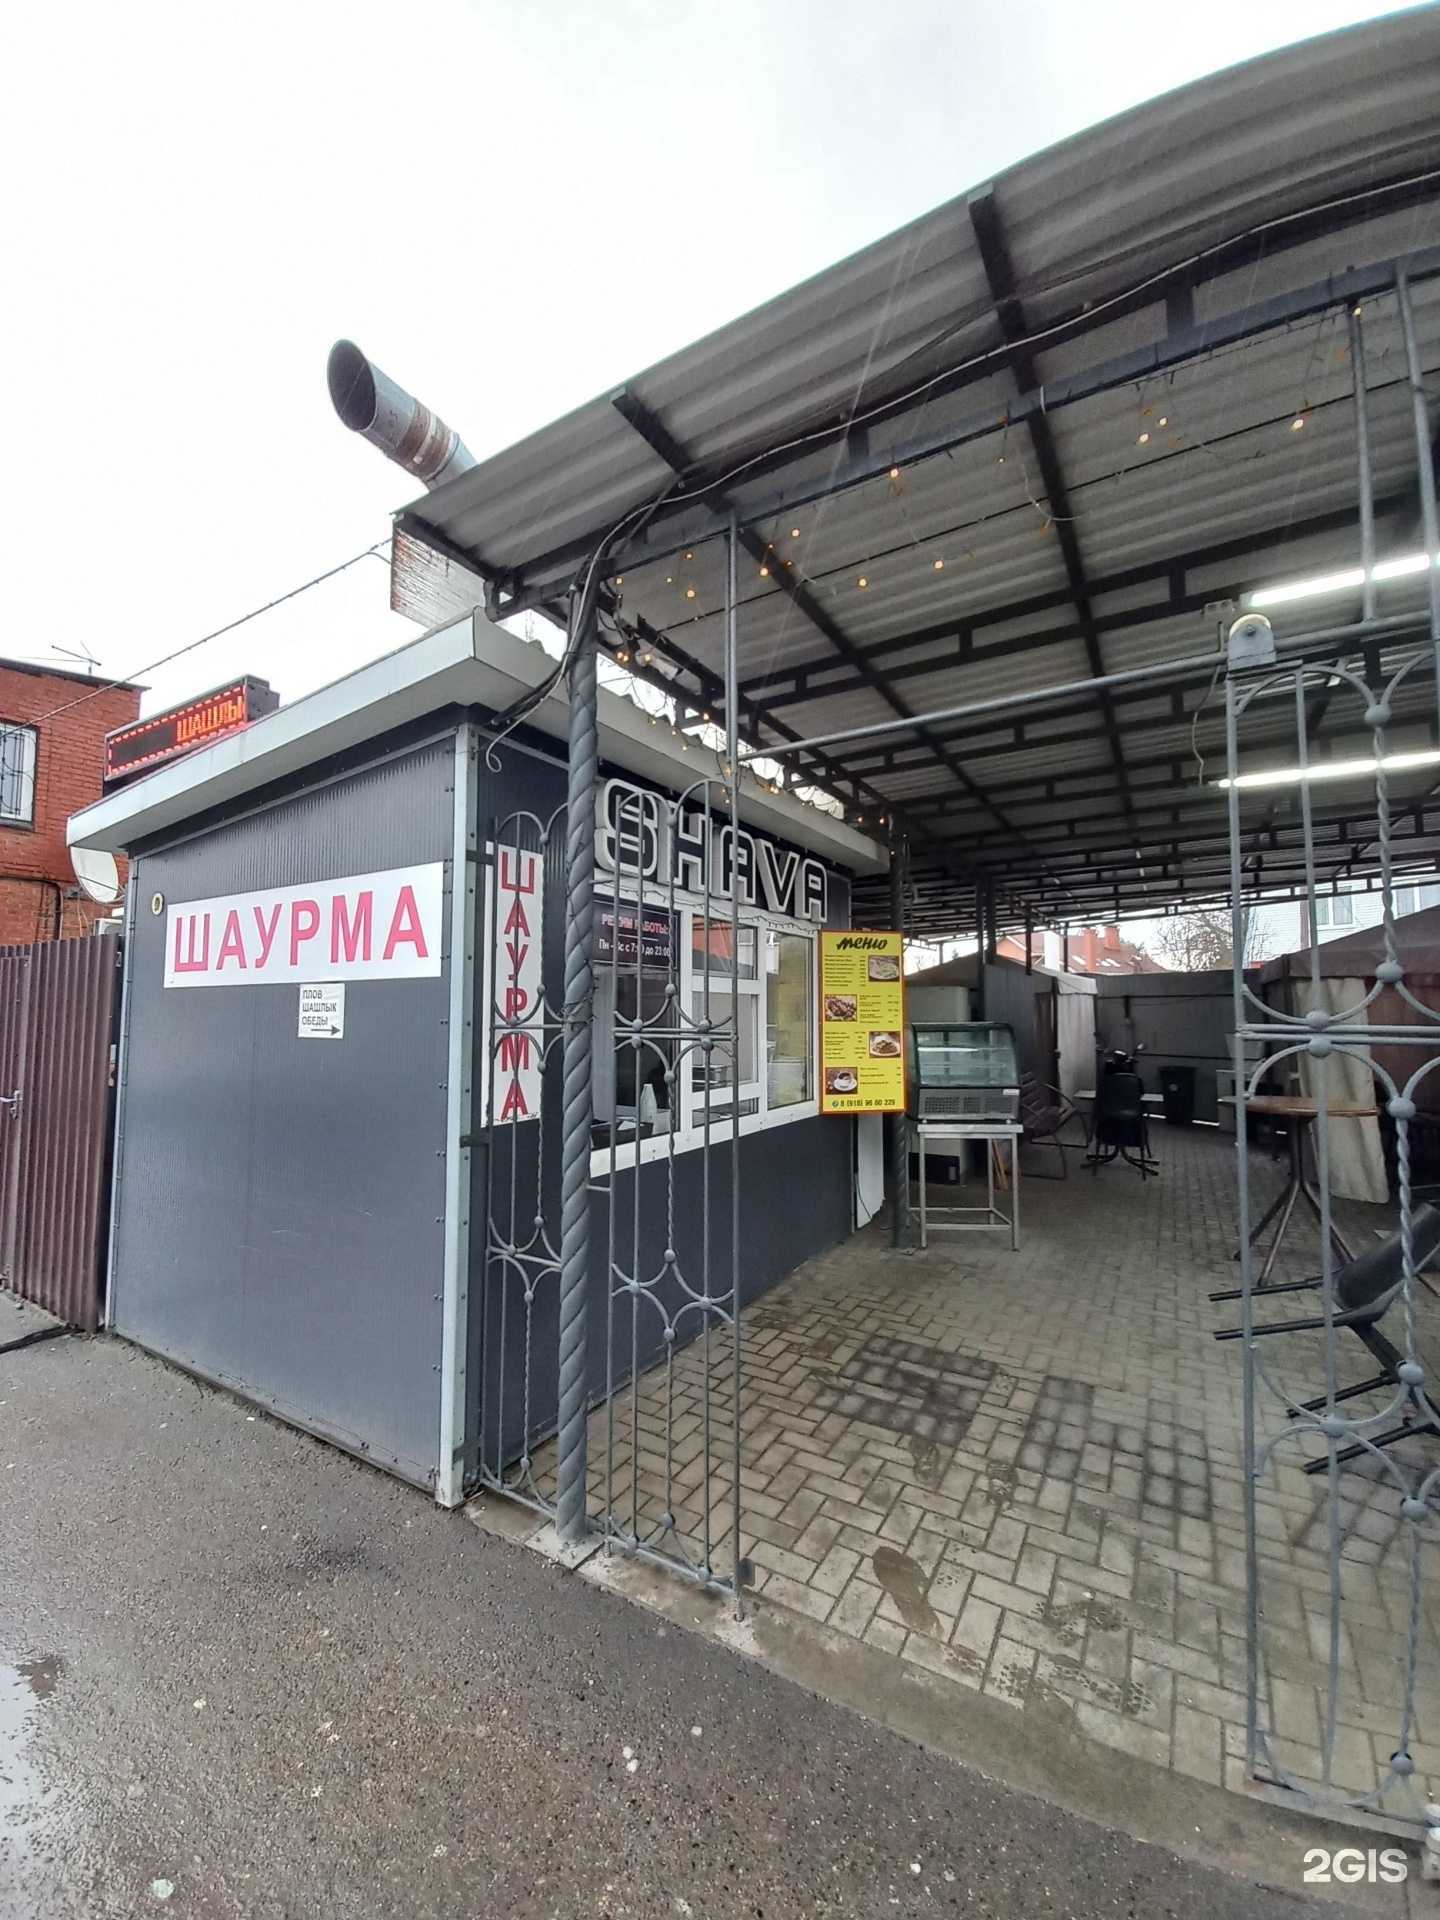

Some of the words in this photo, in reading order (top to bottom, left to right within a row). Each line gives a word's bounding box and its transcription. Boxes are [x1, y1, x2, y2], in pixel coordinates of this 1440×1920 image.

[598, 778, 828, 923] SHAVA
[173, 885, 430, 974] ШАУРМА
[302, 1002, 337, 1013] ШАШЛЫК
[303, 989, 322, 999] ПЛОВ
[500, 851, 536, 1120] ШАУРМА
[301, 1015, 329, 1026] ОБЕДЫ
